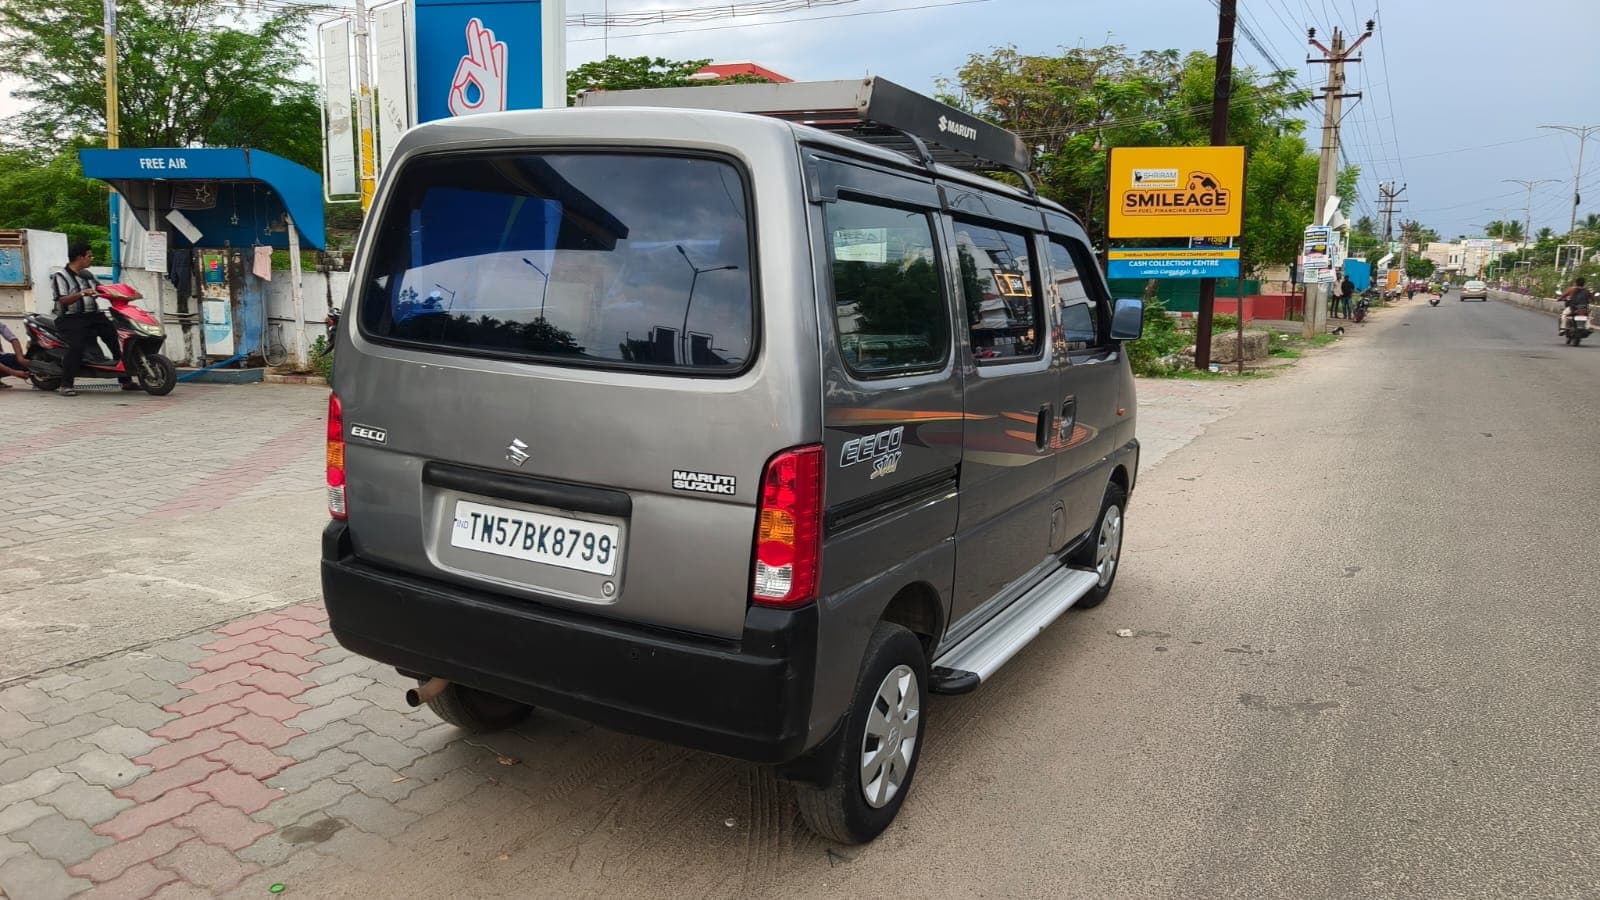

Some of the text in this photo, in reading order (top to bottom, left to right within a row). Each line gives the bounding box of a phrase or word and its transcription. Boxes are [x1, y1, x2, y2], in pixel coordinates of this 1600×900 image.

[947, 119, 977, 141] MARUTI
[139, 158, 188, 169] FREE AIR
[1143, 171, 1177, 179] SHRIRAM
[1126, 192, 1227, 207] SMILEAGE
[351, 426, 386, 441] EECO
[839, 425, 905, 468] EECO
[673, 470, 735, 485] MARUTI
[673, 480, 735, 494] SUZUKI
[456, 519, 469, 529] IND
[470, 511, 612, 564] TN57BK8799
